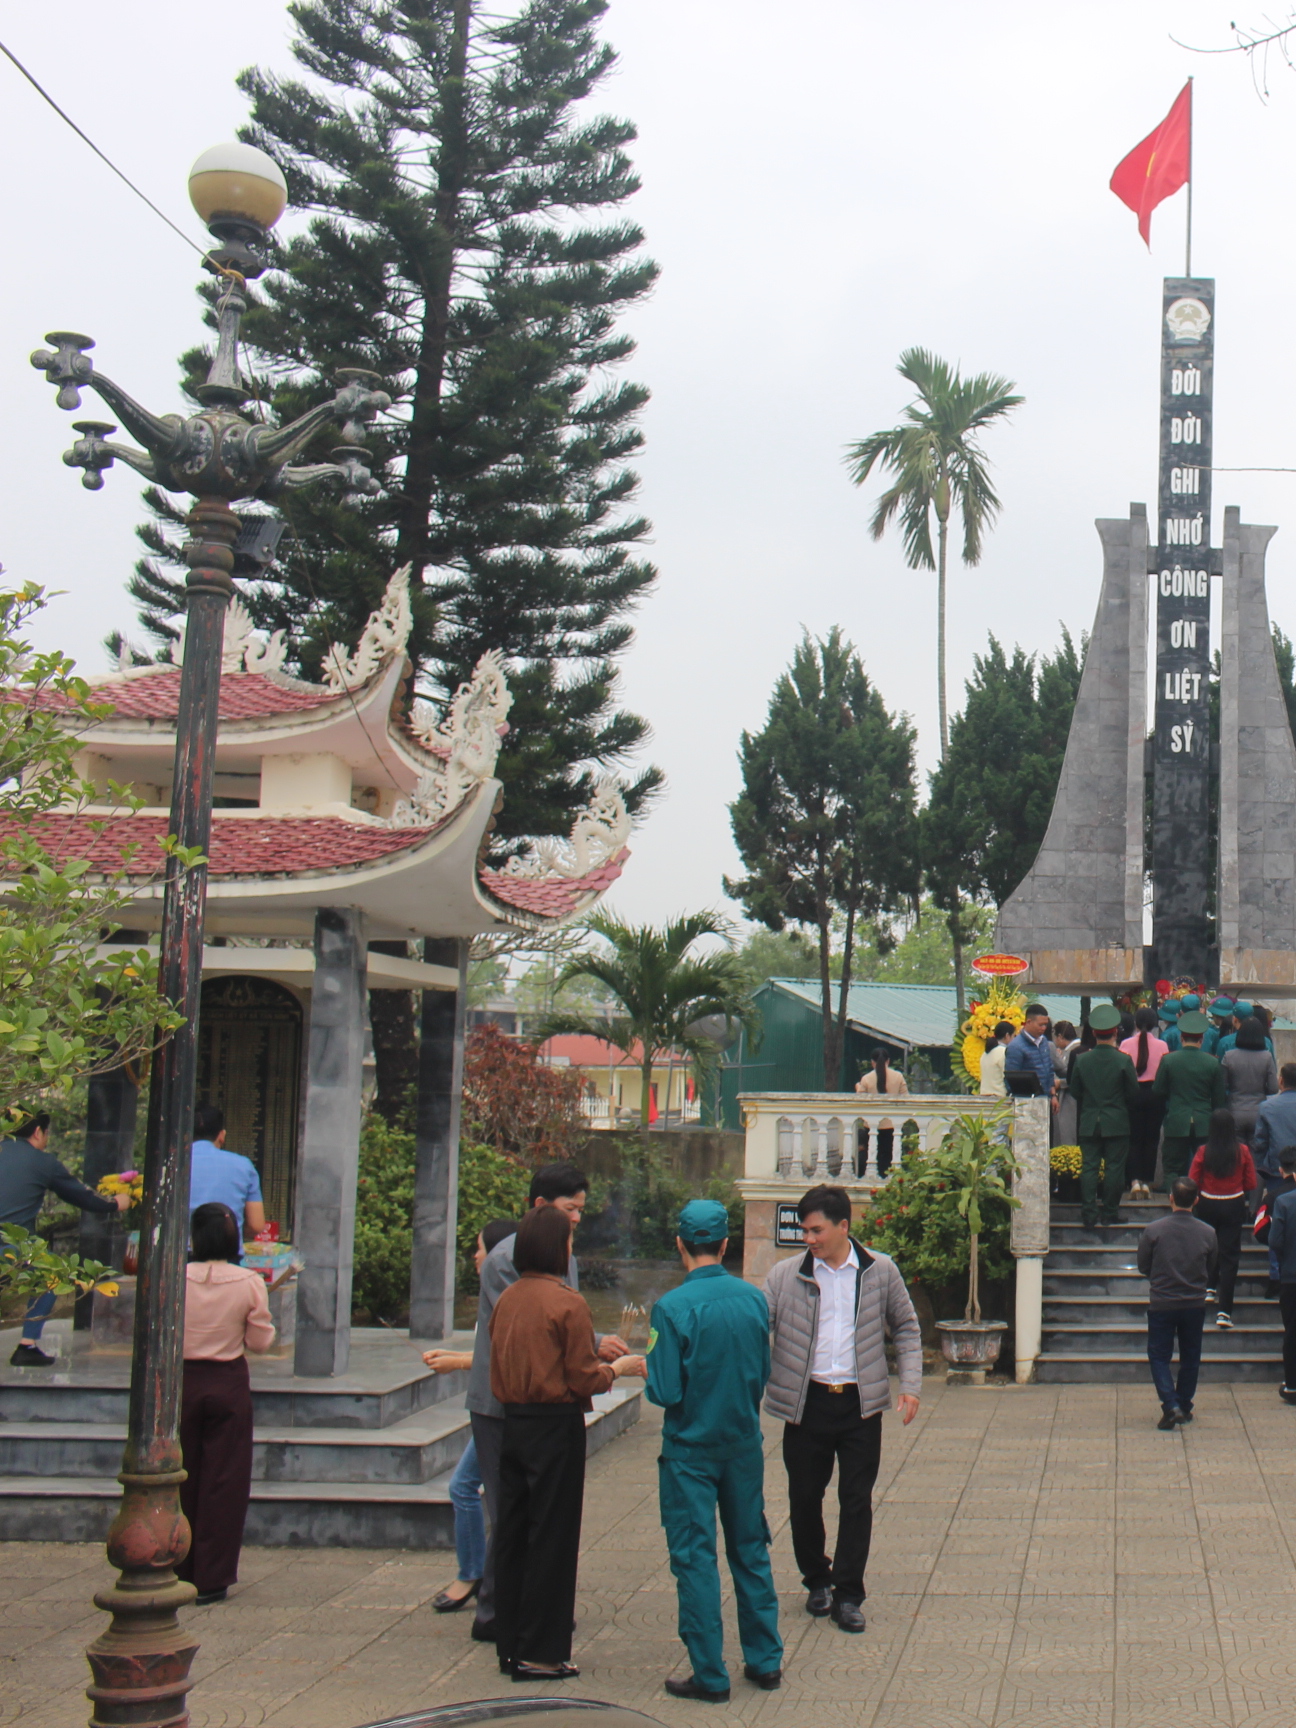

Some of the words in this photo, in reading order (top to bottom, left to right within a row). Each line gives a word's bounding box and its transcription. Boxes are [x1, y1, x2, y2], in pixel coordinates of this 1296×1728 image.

[1171, 362, 1201, 396] ĐỜI
[1171, 411, 1202, 444] ĐỜI
[1171, 467, 1200, 495] GHI
[1166, 512, 1204, 546] NHỚ
[1160, 565, 1208, 598] CÔNG
[1170, 619, 1197, 649] ƠN
[1164, 668, 1202, 704] LIỆT
[1170, 719, 1194, 753] SỸ
